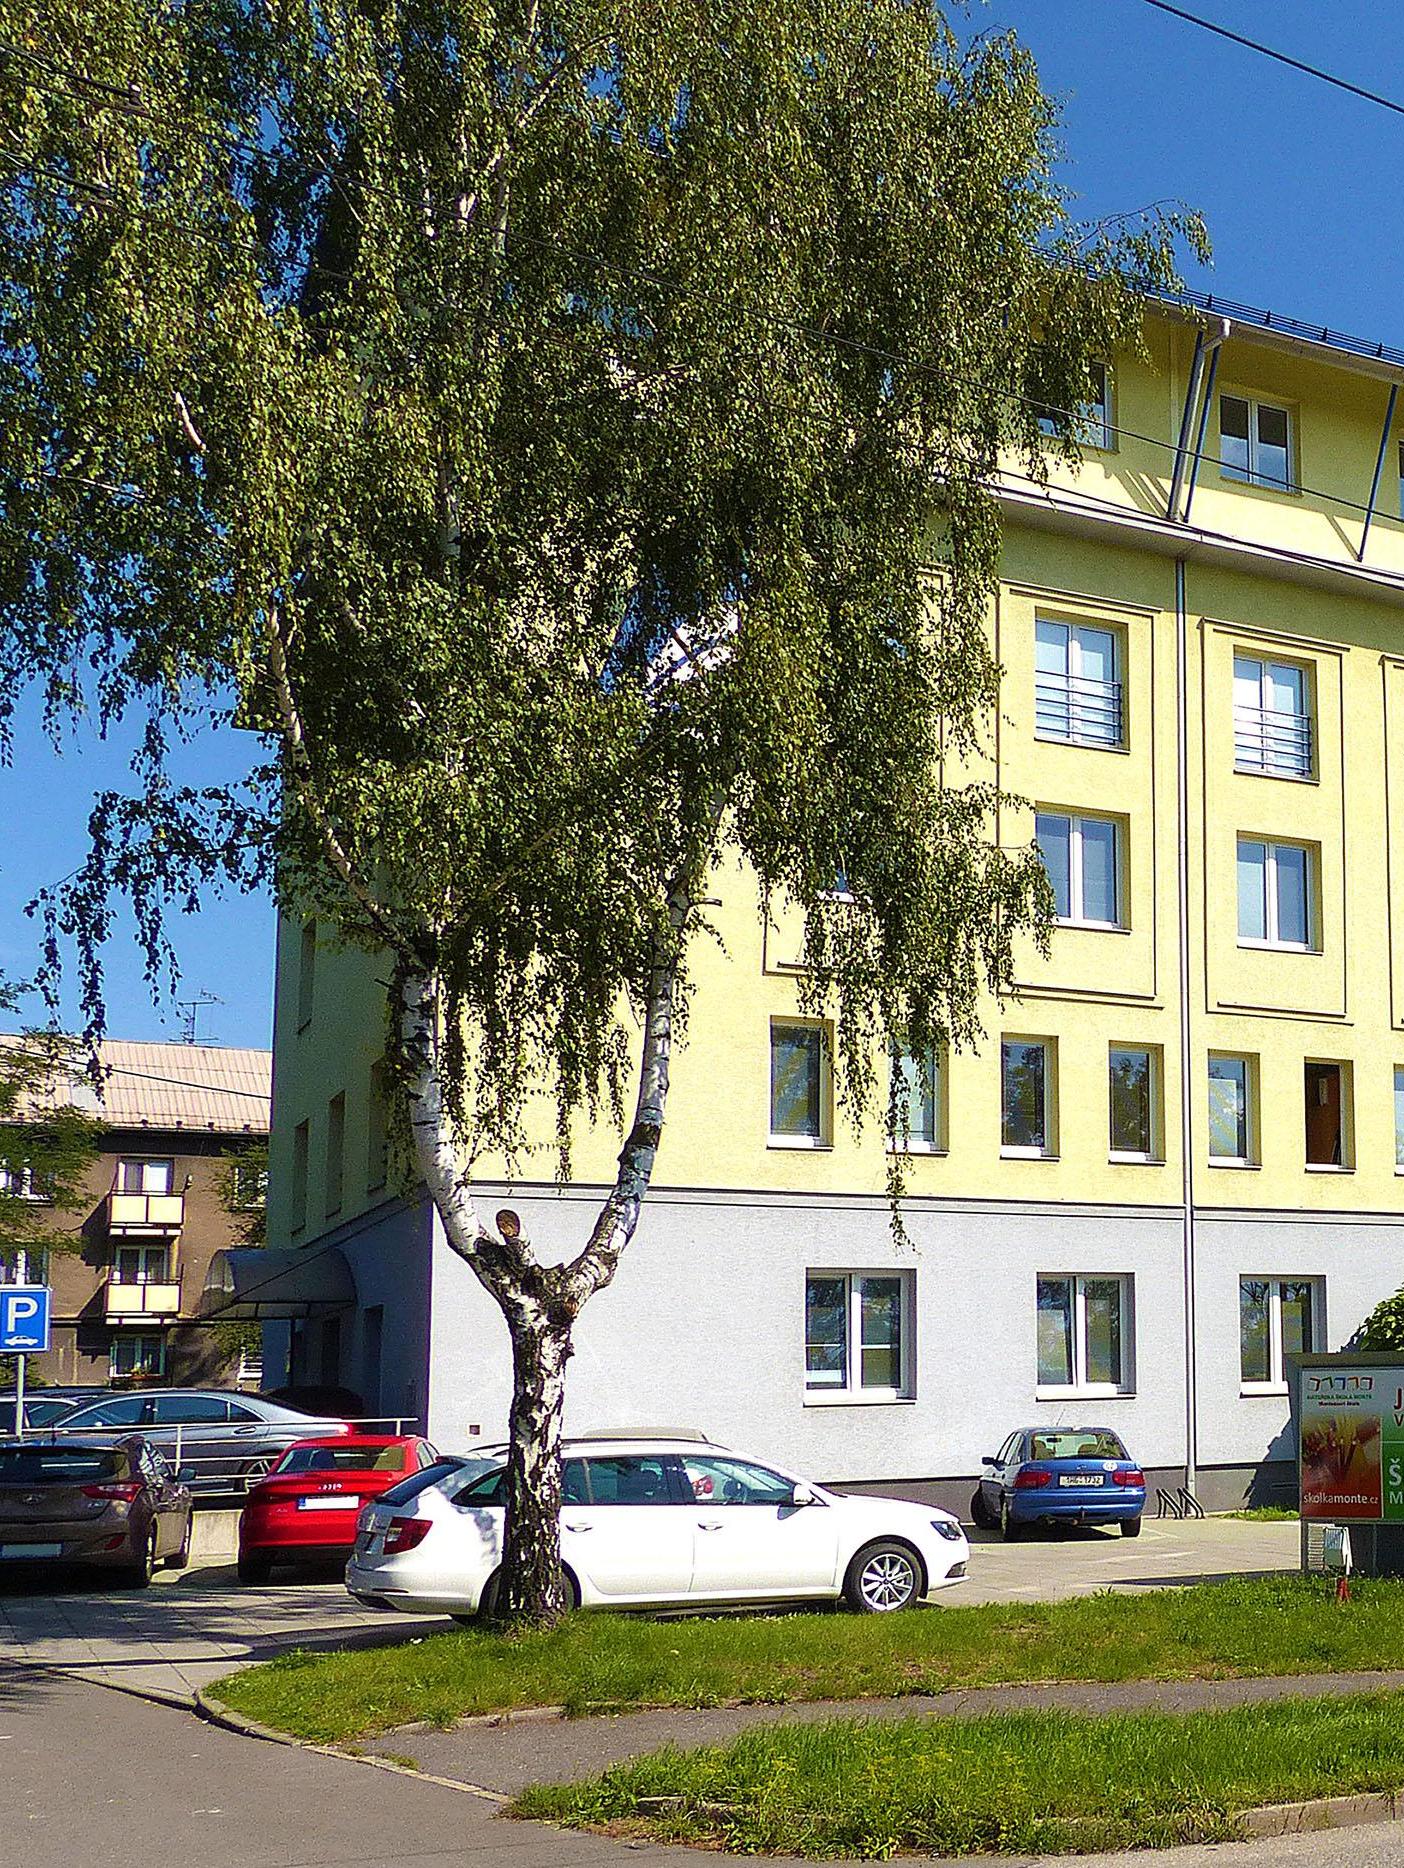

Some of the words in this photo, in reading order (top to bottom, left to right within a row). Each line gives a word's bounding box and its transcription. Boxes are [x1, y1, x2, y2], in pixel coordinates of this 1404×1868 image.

[7, 1296, 38, 1333] P
[1394, 1413, 1404, 1427] V
[1303, 1491, 1379, 1504] skolkamonte.cz
